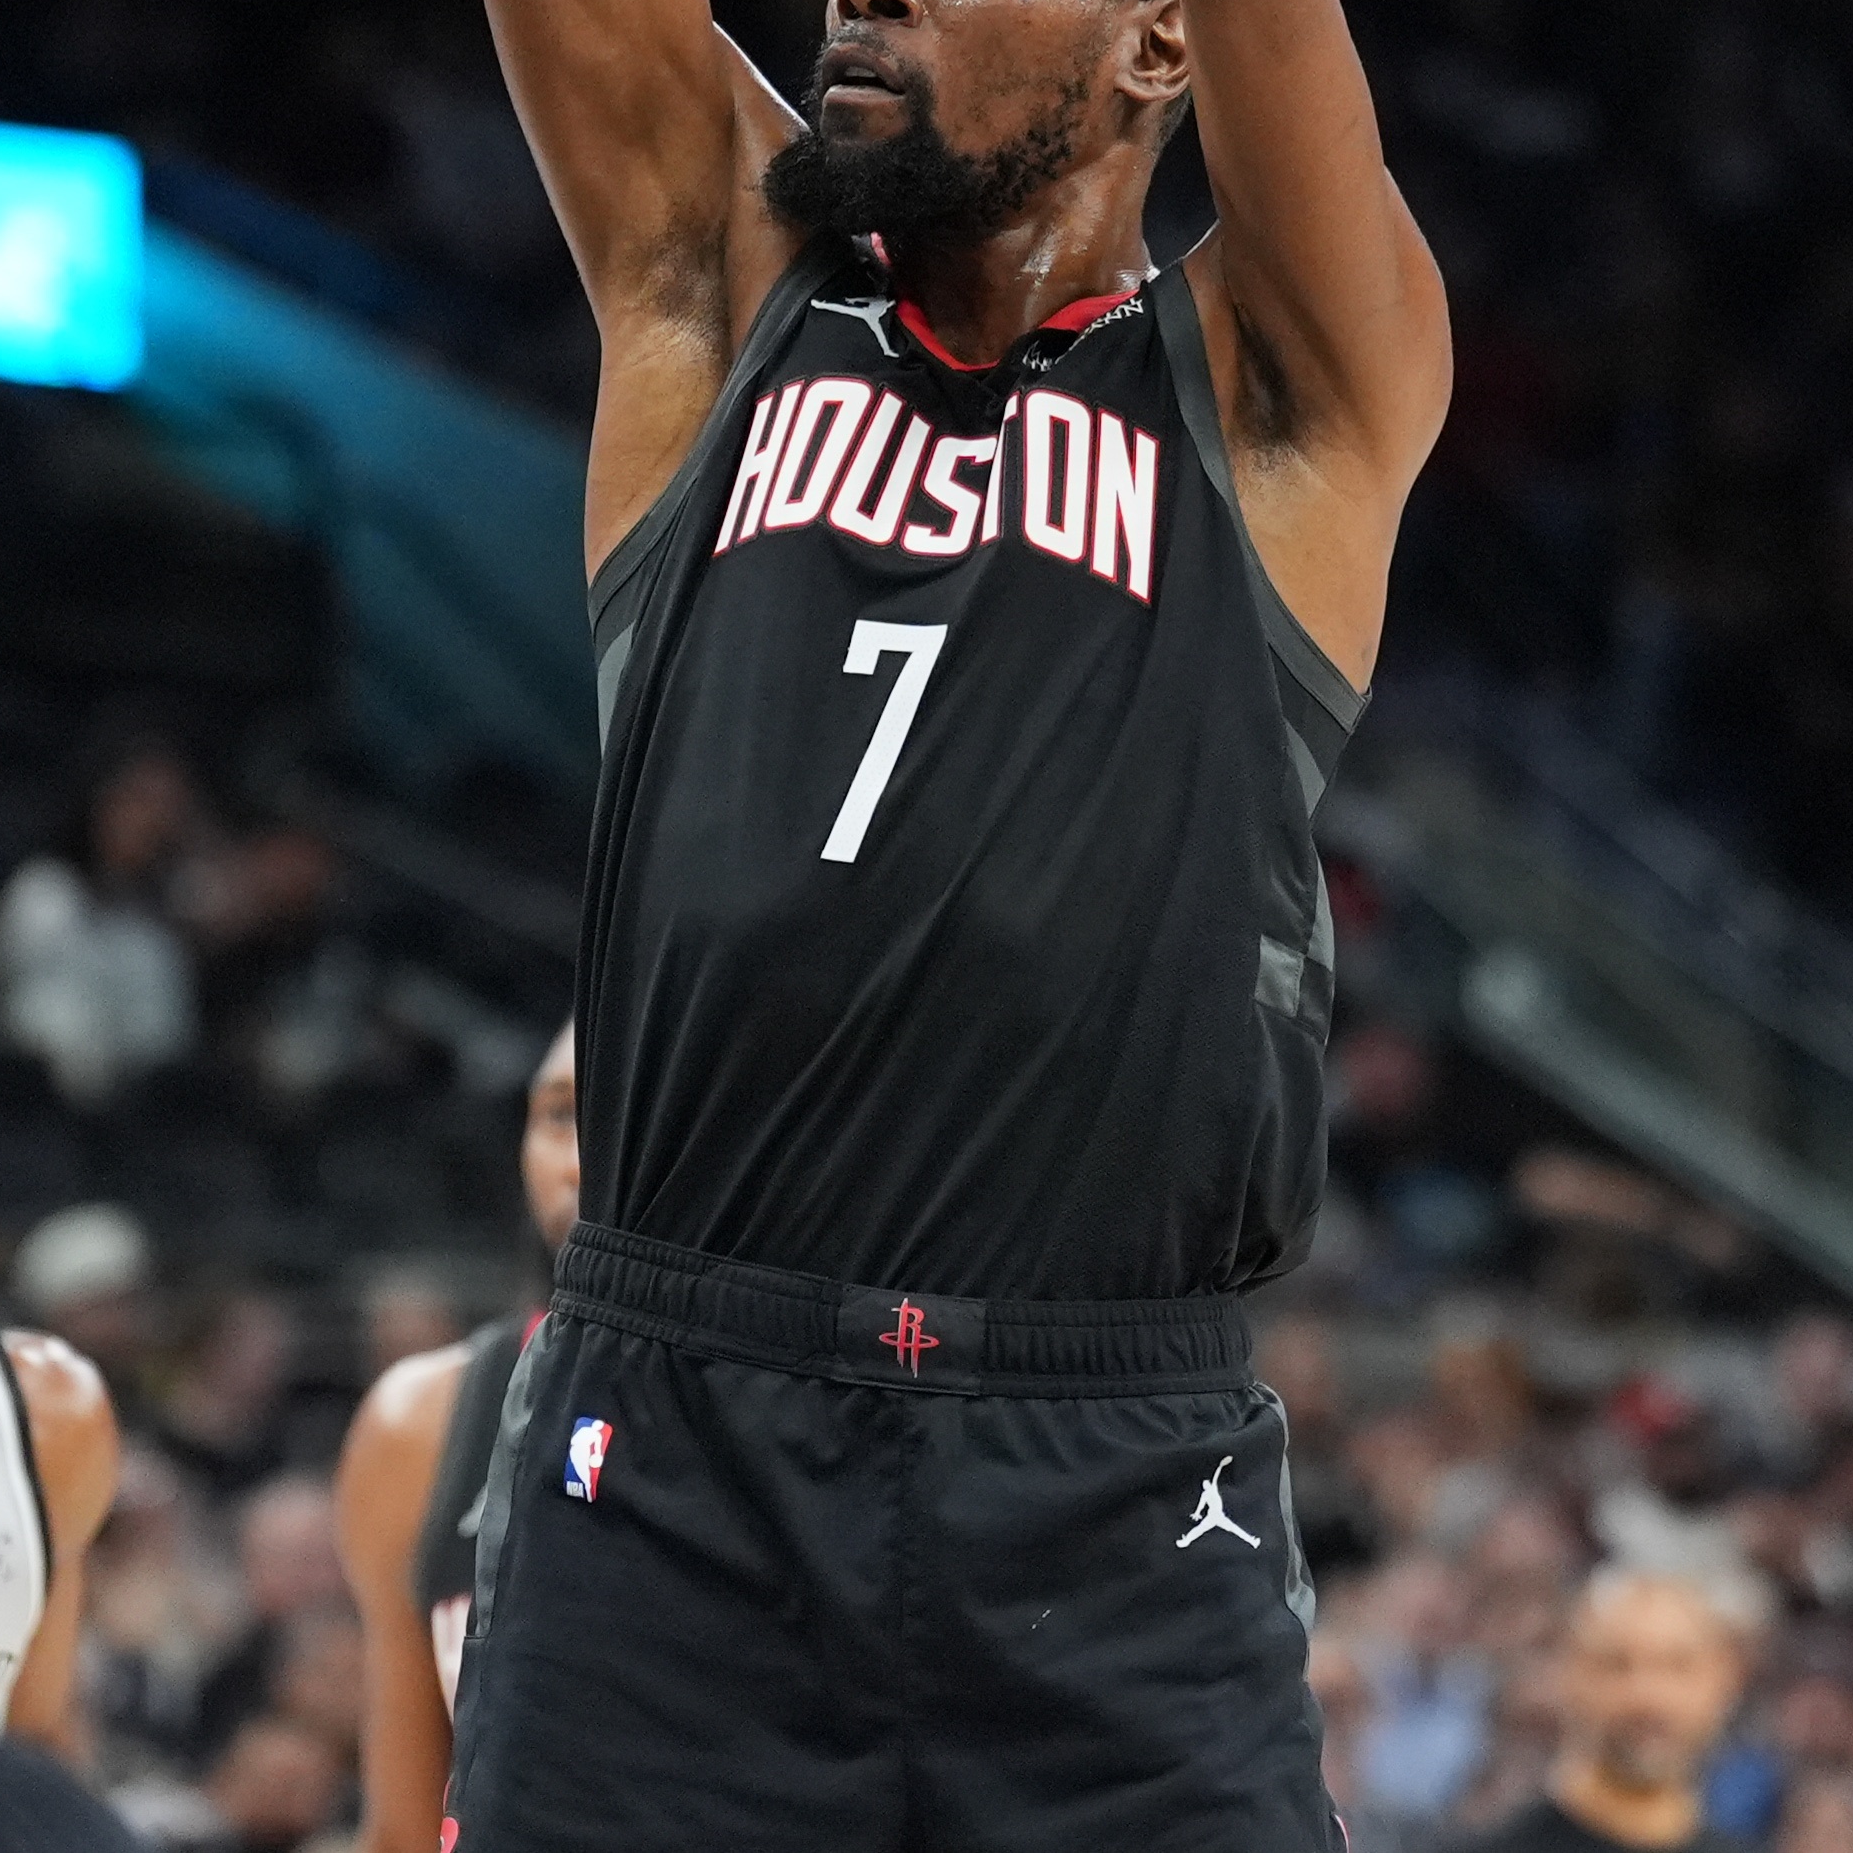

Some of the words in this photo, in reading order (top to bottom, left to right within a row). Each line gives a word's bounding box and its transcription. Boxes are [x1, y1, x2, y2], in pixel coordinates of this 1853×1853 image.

[713, 377, 1160, 605] HOUSTON
[820, 619, 948, 863] 7
[566, 1481, 585, 1499] NBA
